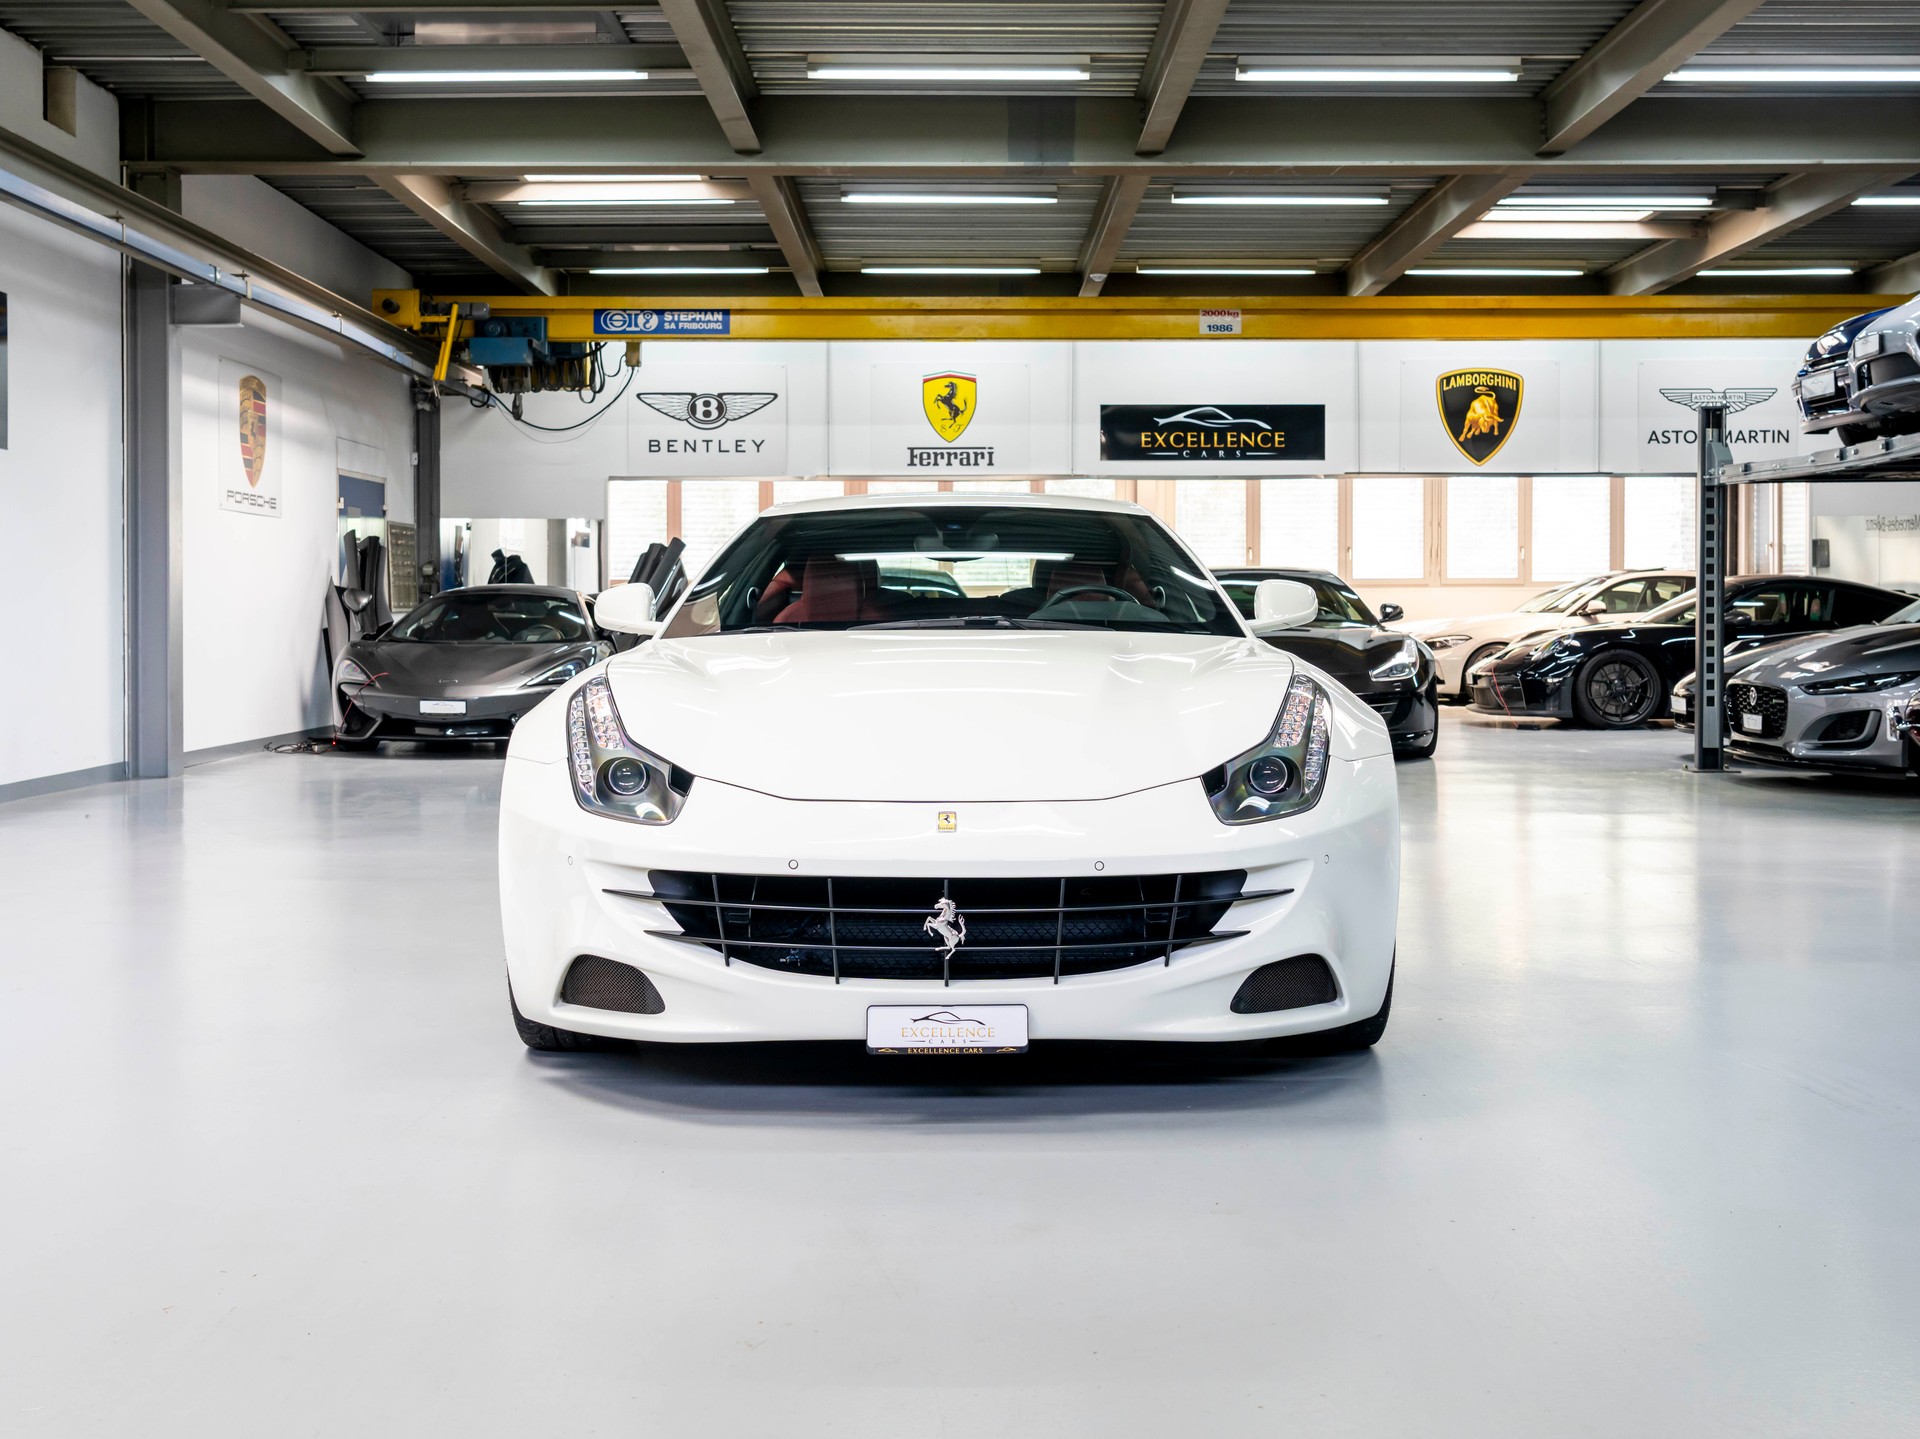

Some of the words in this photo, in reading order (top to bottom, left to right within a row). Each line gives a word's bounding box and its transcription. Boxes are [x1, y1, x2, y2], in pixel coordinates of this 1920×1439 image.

[664, 312, 723, 321] STEPHAN
[1201, 310, 1239, 318] 2000kg
[1207, 324, 1233, 332] 1986
[1443, 373, 1517, 391] LAMBORGHINI
[1693, 393, 1717, 401] ASTON
[695, 399, 719, 421] B
[1141, 431, 1286, 448] EXCELLENCE
[1647, 430, 1698, 444] ASTO
[648, 439, 766, 453] BENTLEY
[907, 446, 995, 467] Ferrari
[1183, 450, 1242, 458] CARS
[227, 489, 277, 510] PORSCHE
[901, 1027, 996, 1038] EXCELLENCE
